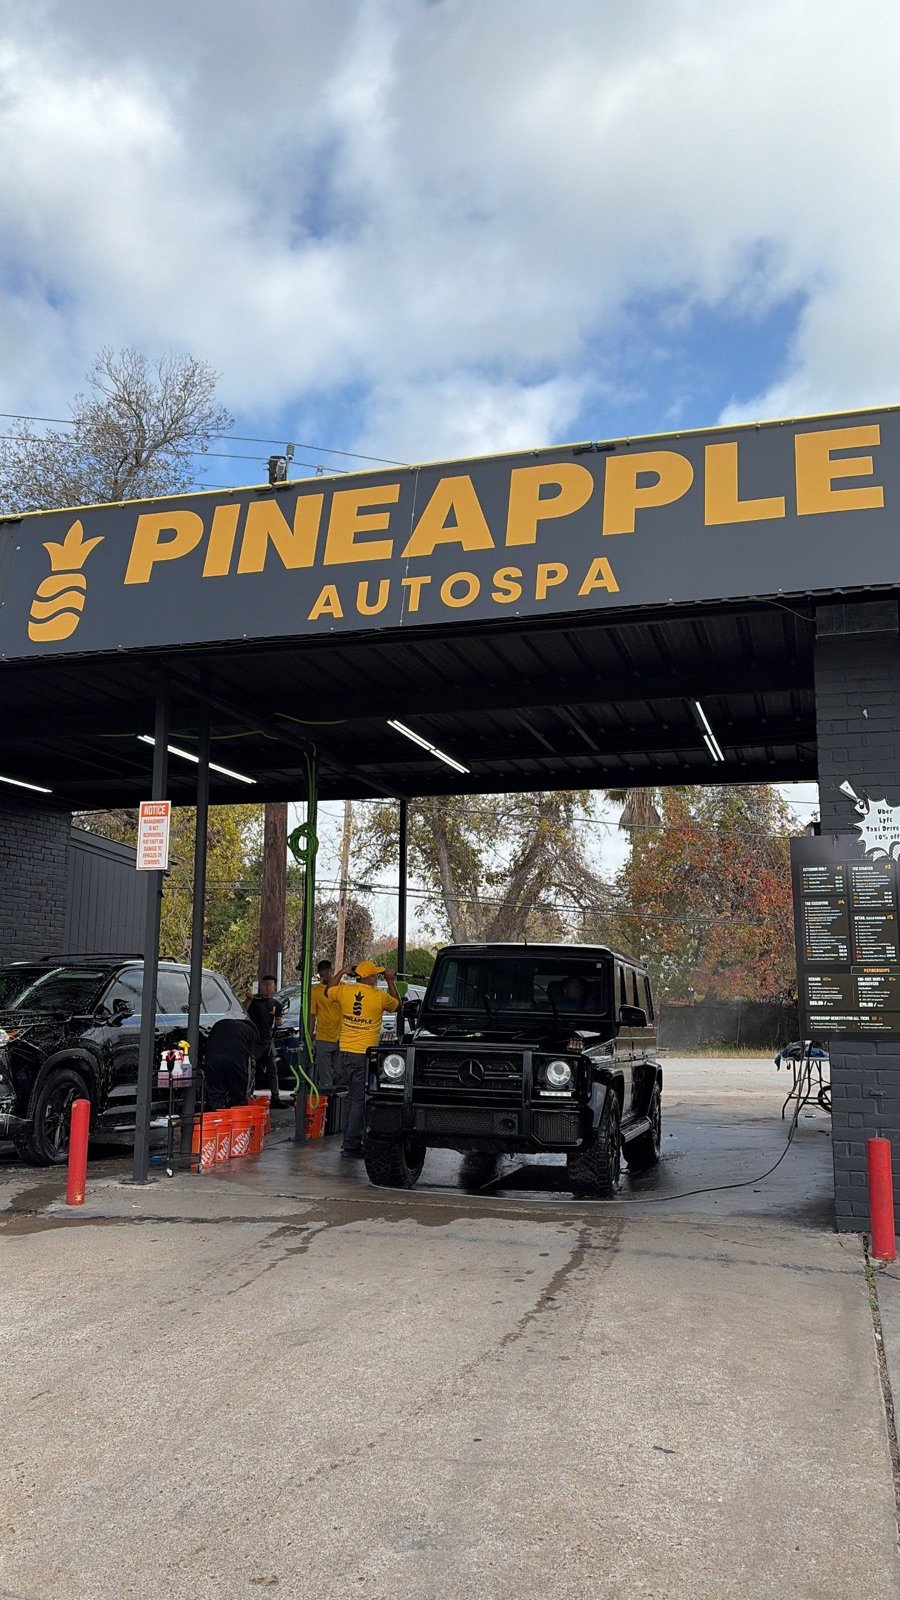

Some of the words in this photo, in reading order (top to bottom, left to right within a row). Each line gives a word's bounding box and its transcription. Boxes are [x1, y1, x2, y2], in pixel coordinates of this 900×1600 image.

[124, 424, 884, 585] PINEAPPLE
[308, 557, 620, 620] AUTOSPA
[144, 804, 166, 815] NOTICE
[879, 816, 893, 824] Lyft
